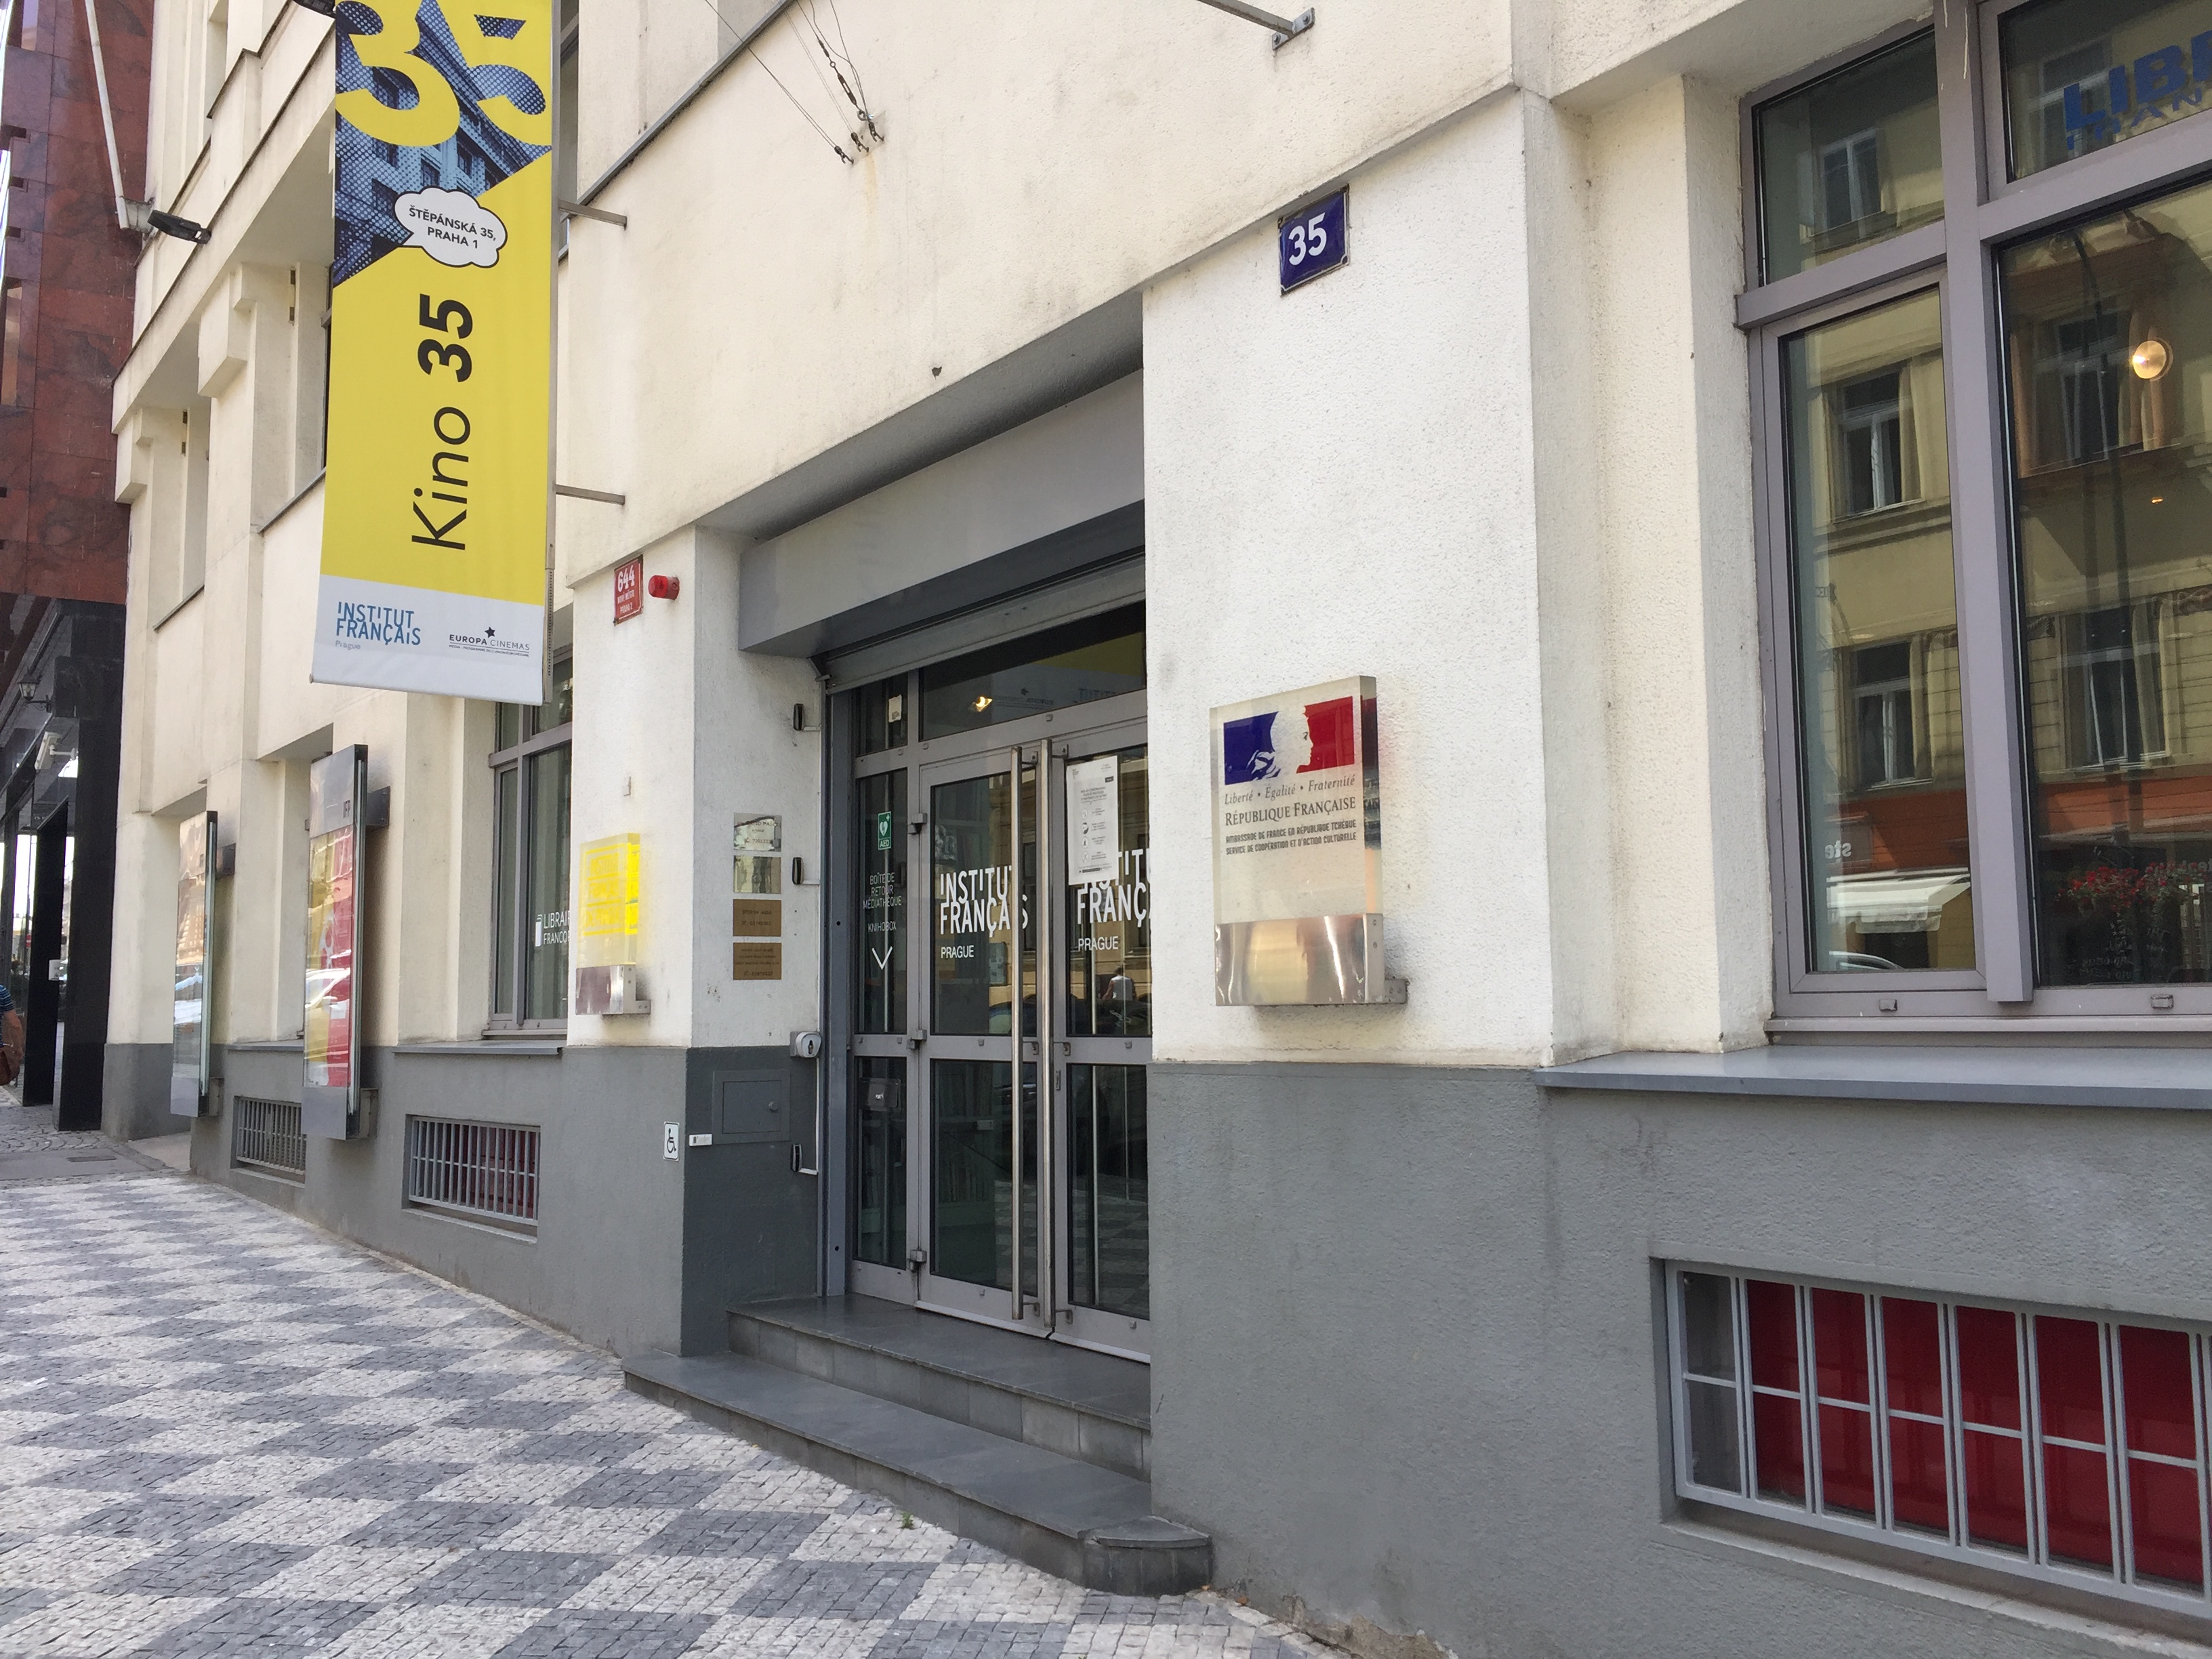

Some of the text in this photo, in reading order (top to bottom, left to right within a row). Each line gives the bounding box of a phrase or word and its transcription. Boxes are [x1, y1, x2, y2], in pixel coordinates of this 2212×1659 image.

[409, 205, 496, 241] ŠTĚPÁNSKÁ 35,
[427, 226, 478, 249] PRAHA 1
[1288, 212, 1327, 266] 35
[411, 293, 474, 551] Kino 35
[617, 565, 635, 592] 644
[337, 601, 415, 628] INSTITUT
[336, 617, 421, 645] FRANÇAIS
[449, 634, 530, 651] EUROPA CINEMAS
[335, 640, 361, 650] Prague
[1225, 774, 1355, 804] Liberté Égalité Fraternité
[1225, 806, 1290, 826] RÉPUBLIQUE
[1294, 796, 1356, 817] FRANÇAISE
[880, 839, 890, 847] AED
[1226, 832, 1256, 844] AMBASSADE
[1258, 831, 1265, 840] DE
[1266, 827, 1286, 838] FRANCE
[1226, 845, 1246, 855] SERVICE
[1247, 844, 1254, 853] DE
[1290, 839, 1296, 847] ET
[1323, 832, 1357, 844] CULTURELLE
[869, 872, 895, 885] BOÎTE DE
[871, 884, 894, 897] RETOUR
[940, 865, 1012, 907] INSTITU
[940, 894, 1028, 937] FRANÇAS
[1078, 882, 1150, 927] FRANÇ
[868, 920, 897, 933] KNIHOBOX
[941, 945, 974, 959] PRAGUE
[1078, 935, 1118, 952] PRAGUE
